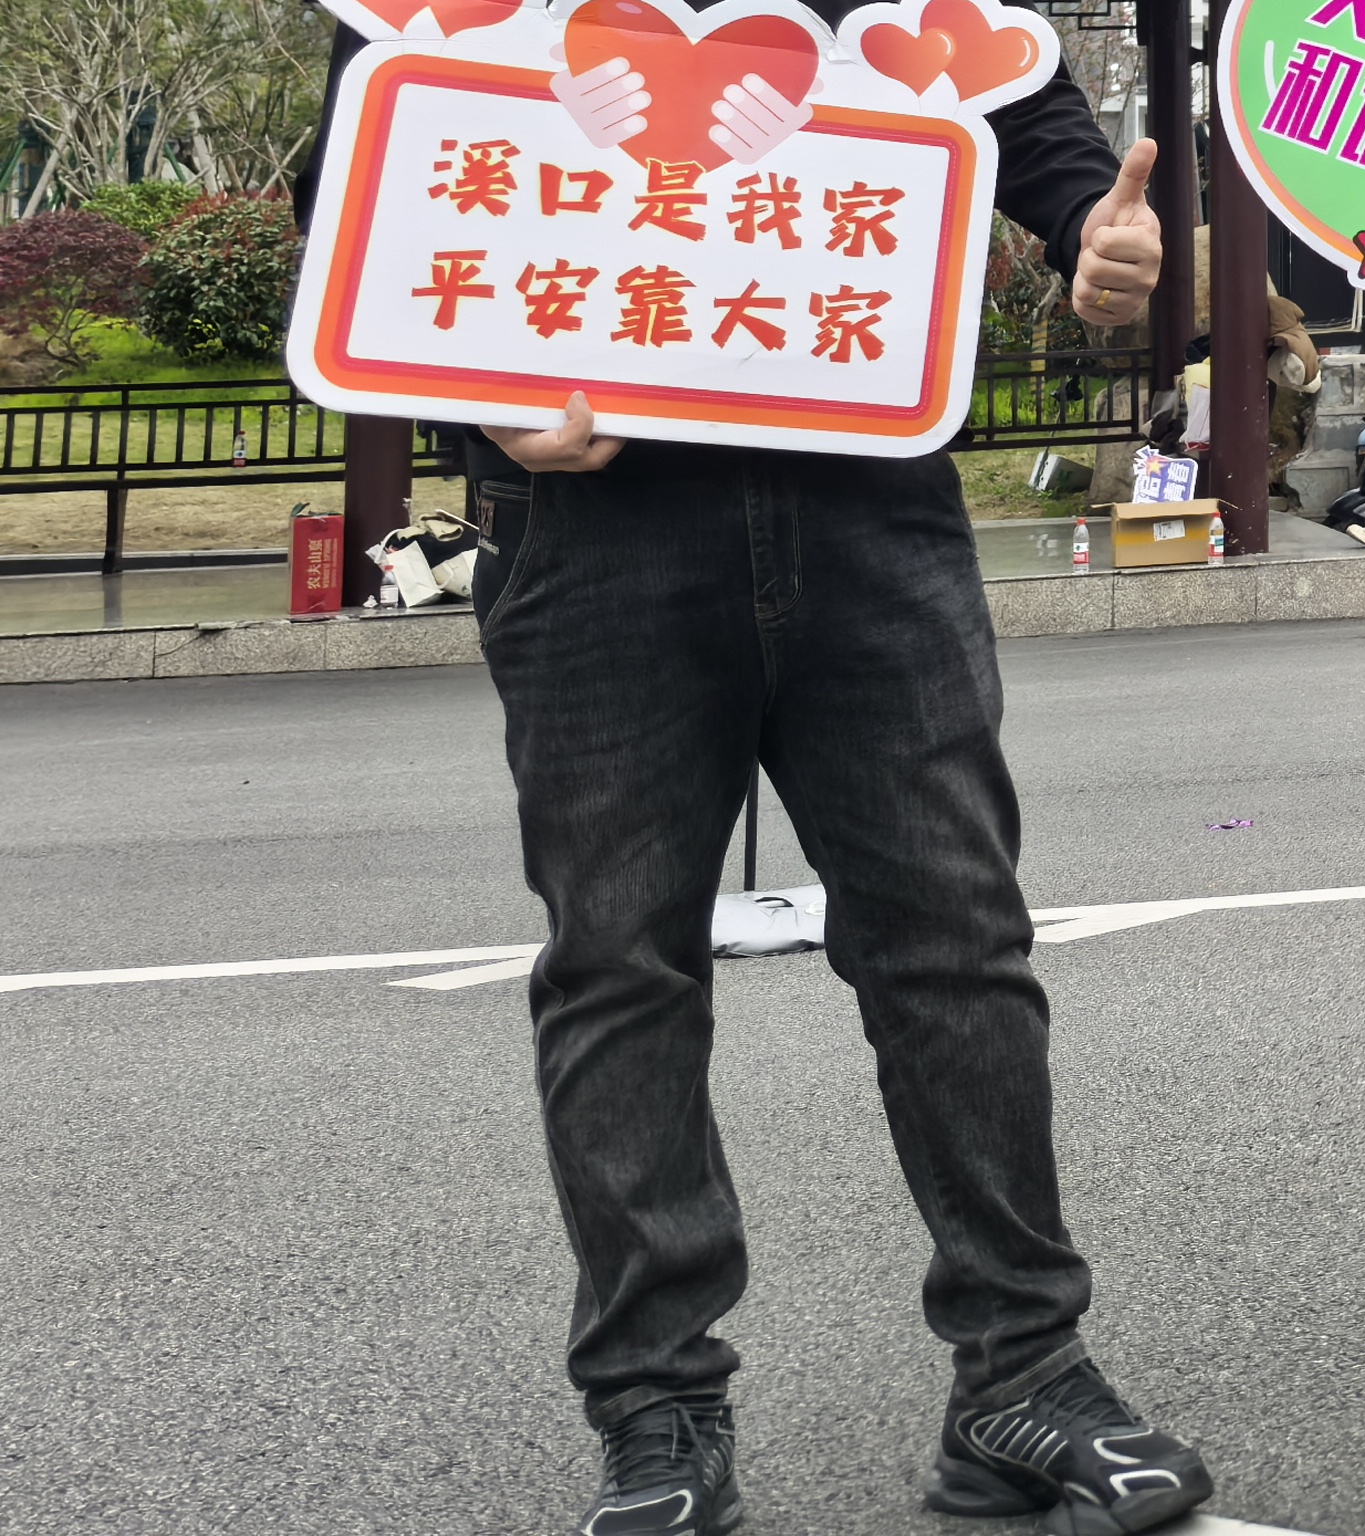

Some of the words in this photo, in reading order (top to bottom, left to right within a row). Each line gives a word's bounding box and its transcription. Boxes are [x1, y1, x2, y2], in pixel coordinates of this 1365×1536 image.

[427, 137, 906, 257] 溪口是我家
[411, 248, 892, 364] 平安靠大家
